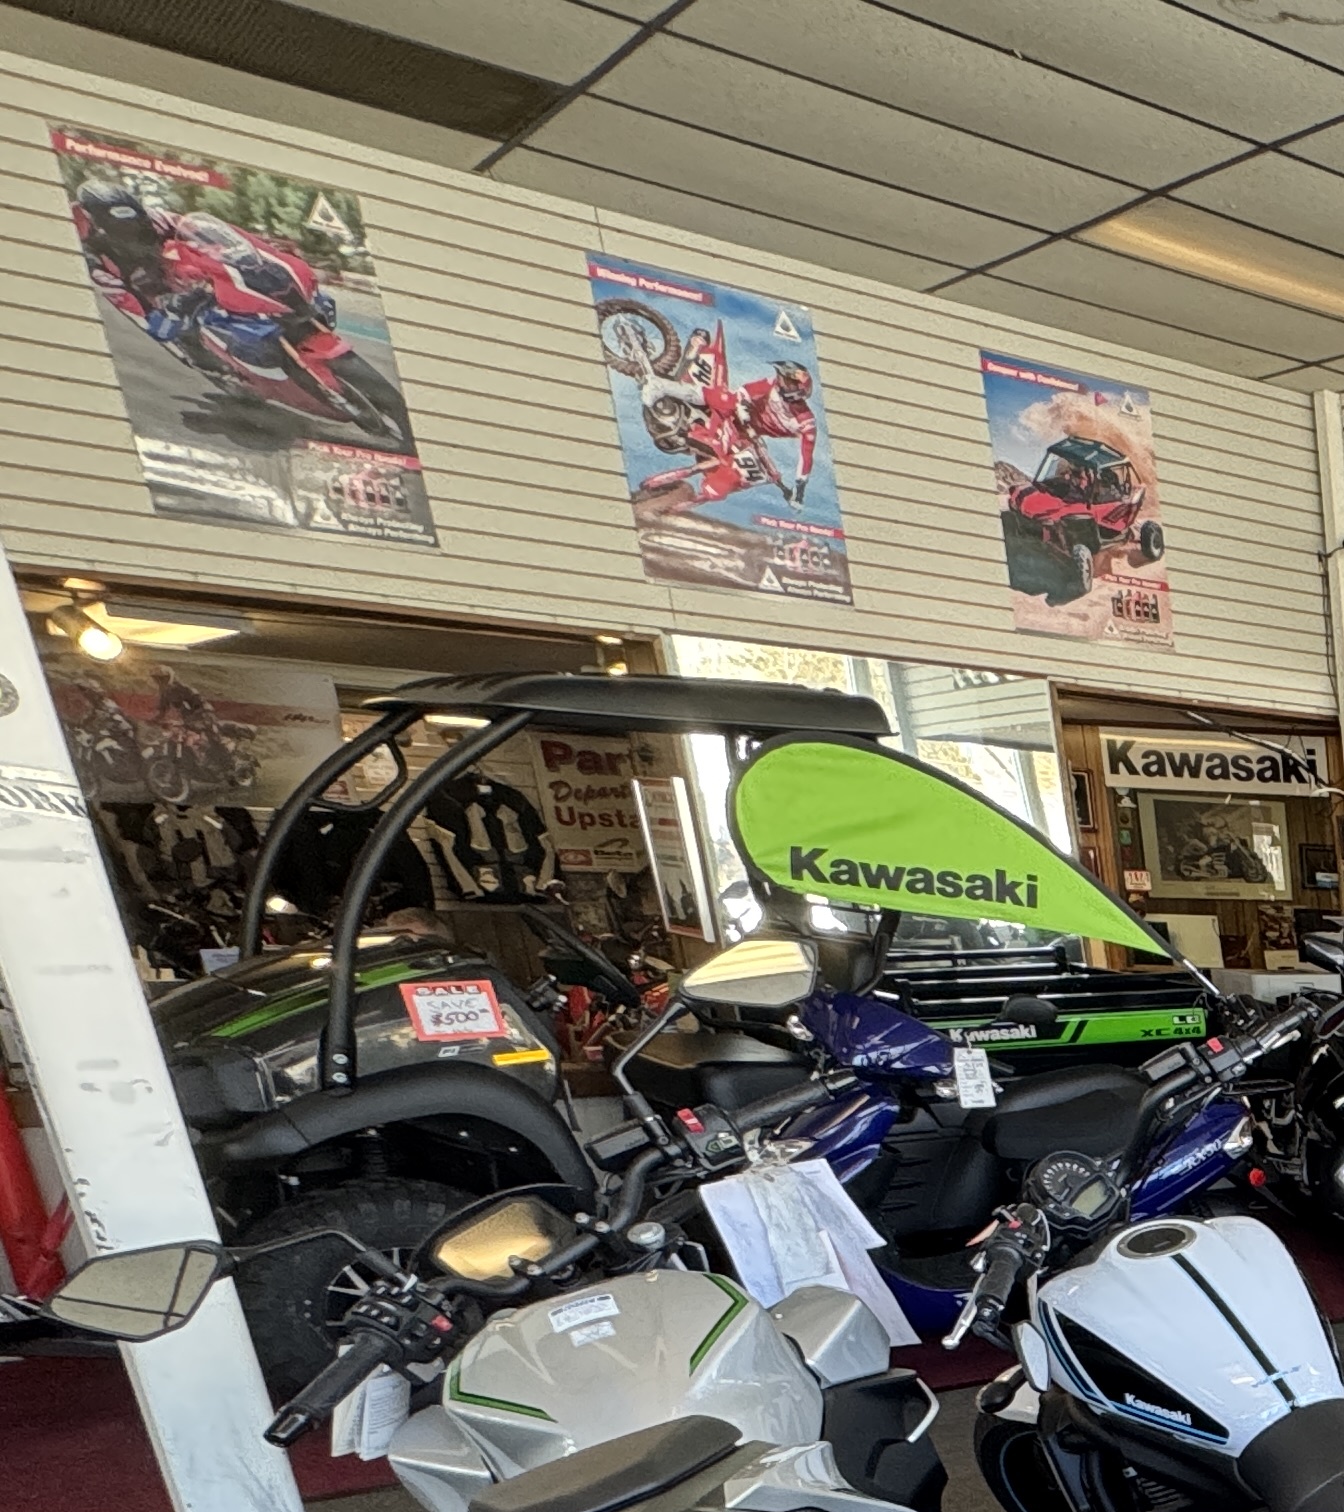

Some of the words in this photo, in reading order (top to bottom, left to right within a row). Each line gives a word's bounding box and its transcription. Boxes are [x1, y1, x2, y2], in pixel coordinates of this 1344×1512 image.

[1108, 740, 1318, 784] Kawasaki
[790, 845, 1039, 909] Kawasaki
[416, 985, 482, 996] SALE
[427, 999, 477, 1011] SAVE
[950, 1014, 1038, 1043] Kawasaki
[1123, 1392, 1192, 1426] Kawasaki
